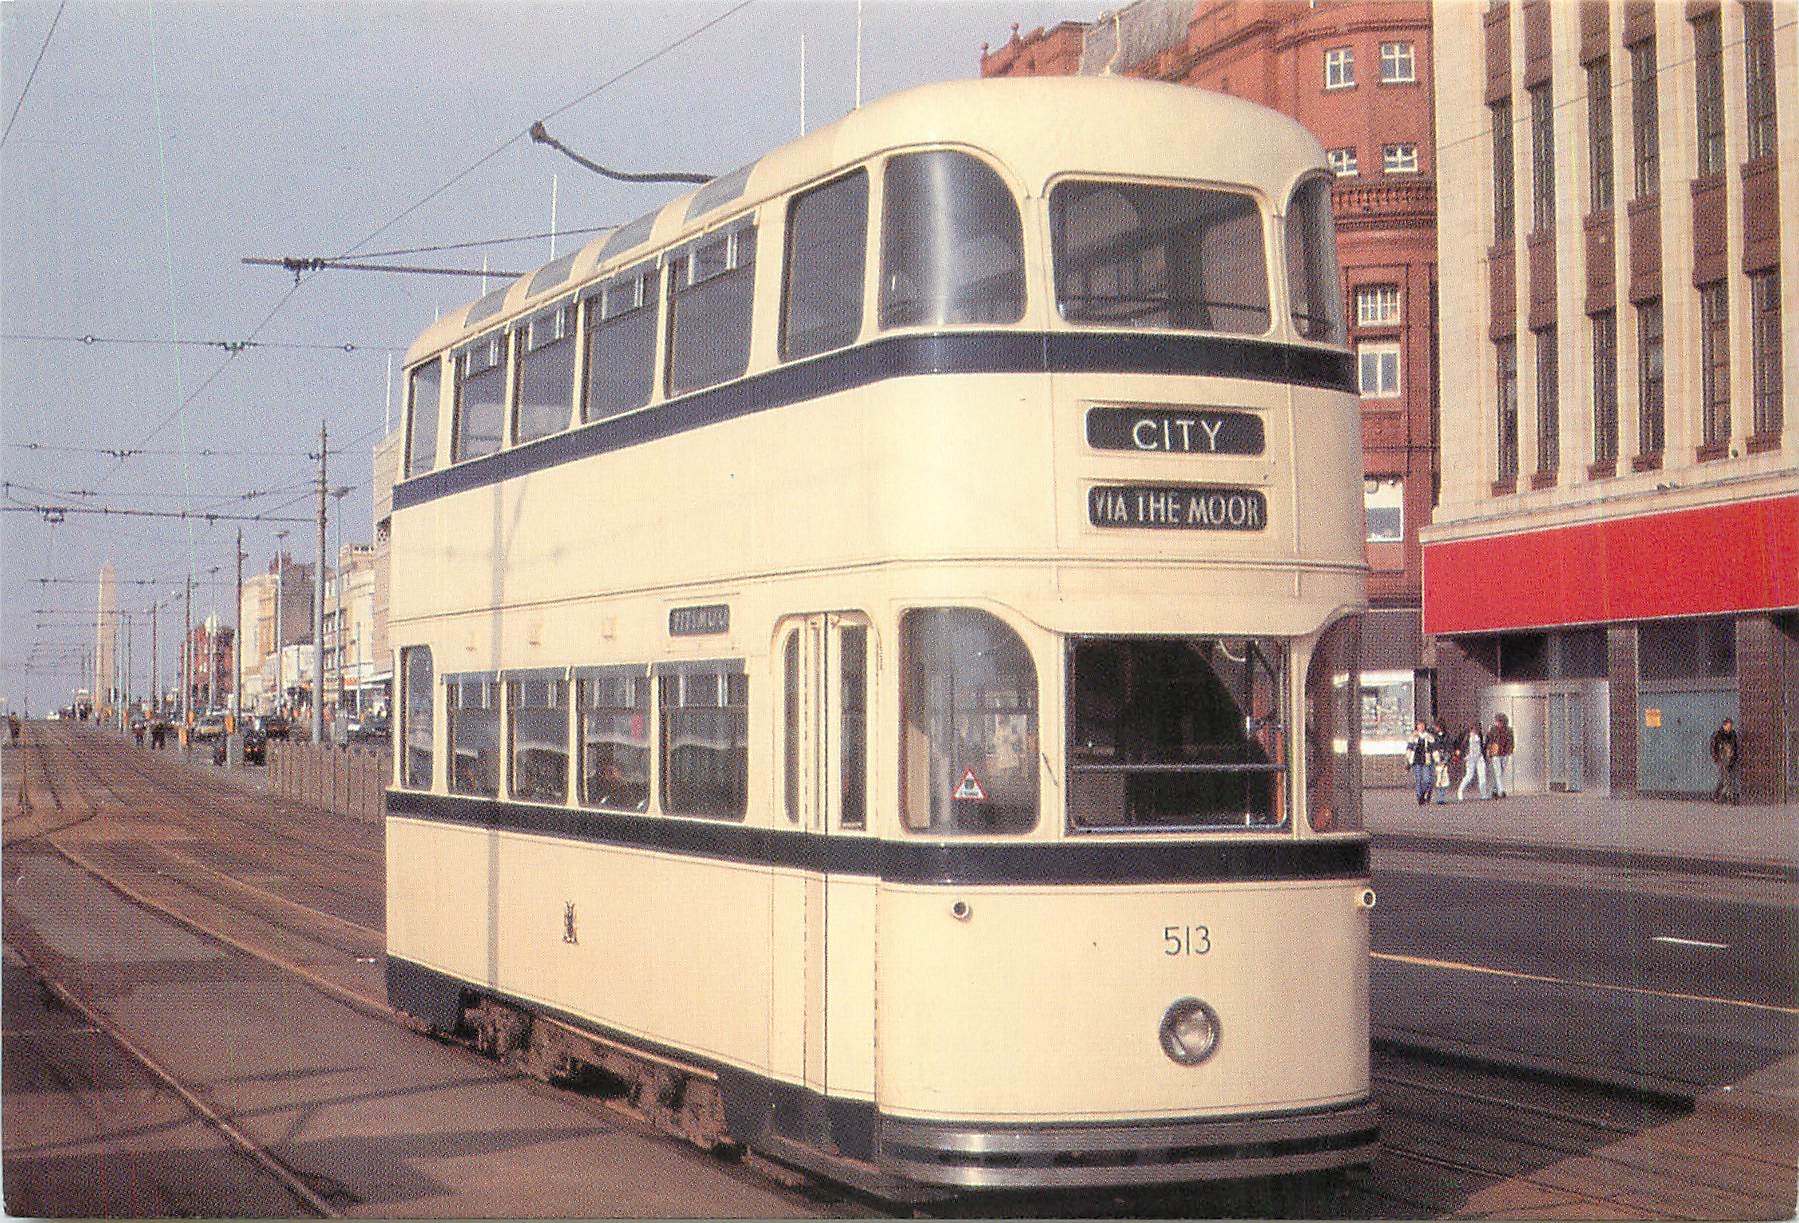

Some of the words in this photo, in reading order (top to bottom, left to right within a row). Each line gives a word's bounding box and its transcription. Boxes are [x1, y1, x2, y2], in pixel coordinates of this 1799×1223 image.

[1132, 419, 1222, 450] CITY
[1095, 494, 1128, 521] VIA
[1137, 493, 1179, 523] THE
[1188, 495, 1259, 526] MOOR
[1164, 925, 1211, 956] 513
